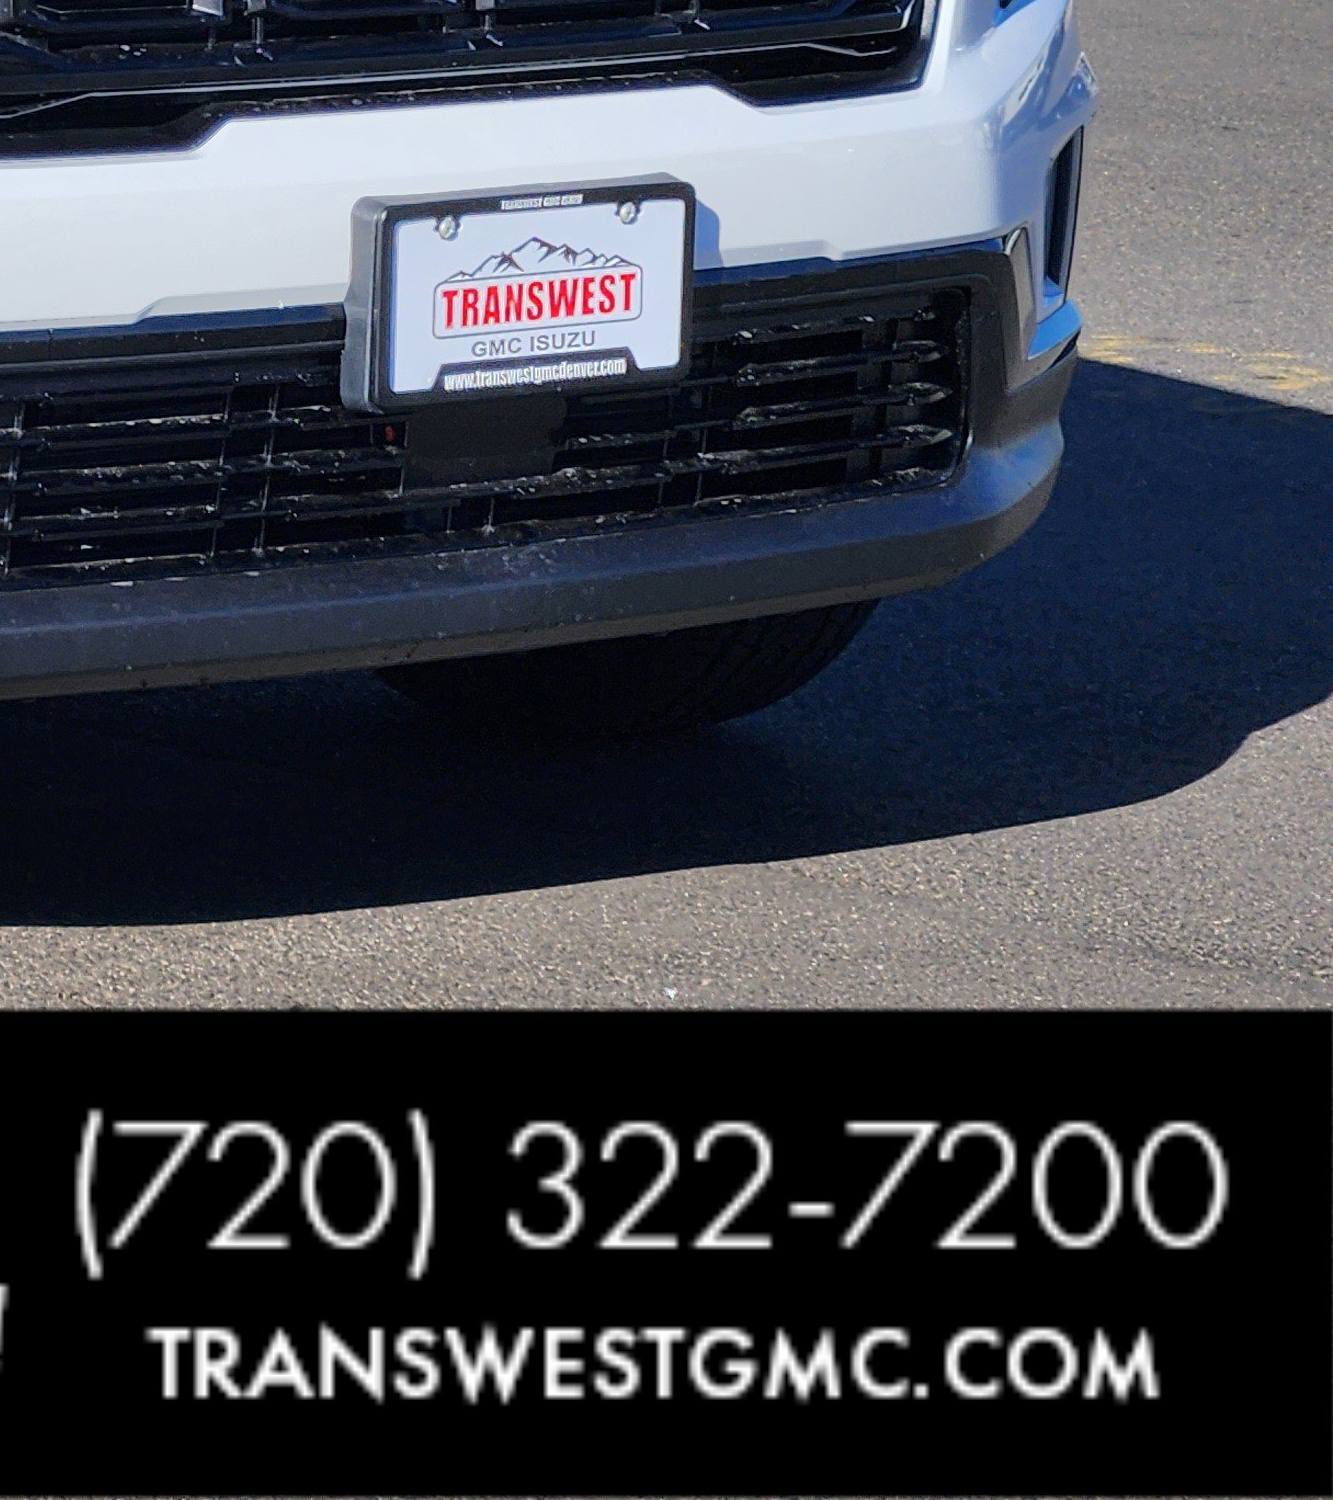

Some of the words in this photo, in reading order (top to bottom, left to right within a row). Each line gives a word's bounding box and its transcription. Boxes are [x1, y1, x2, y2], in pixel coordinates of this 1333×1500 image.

[442, 273, 637, 329] TRANSWEST
[471, 337, 522, 357] GMC
[530, 330, 596, 352] ISUZU
